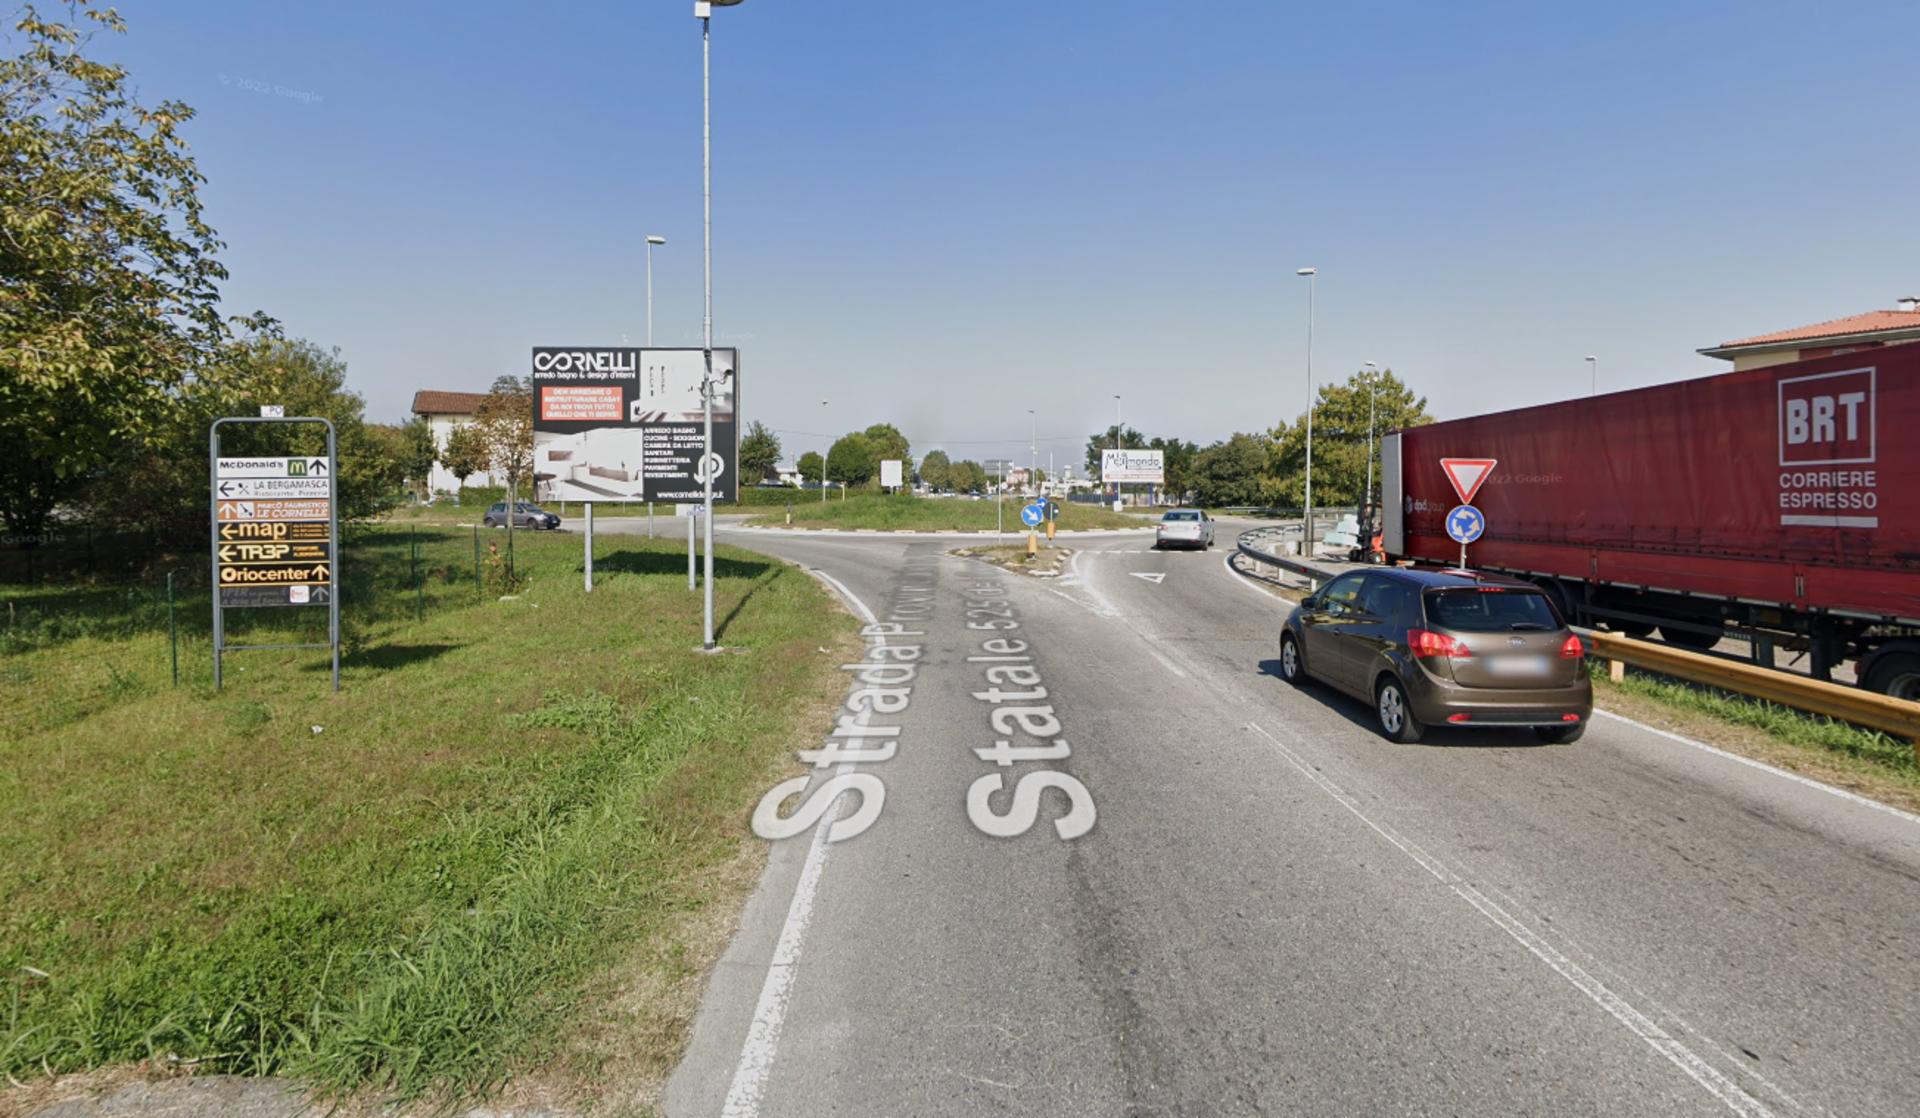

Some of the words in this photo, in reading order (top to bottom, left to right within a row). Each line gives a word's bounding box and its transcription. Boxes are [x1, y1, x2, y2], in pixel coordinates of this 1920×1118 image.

[534, 352, 636, 371] CORNELLI
[534, 371, 556, 379] arredo
[557, 371, 578, 380] bagno
[587, 371, 609, 380] design
[1786, 391, 1865, 445] BRT
[219, 461, 284, 469] McDonald's
[253, 481, 265, 490] LA
[267, 480, 328, 489] BERGAMASCA
[1779, 471, 1876, 489] CORRIERE
[1779, 492, 1877, 509] ESPRESSO
[256, 509, 270, 518] LE
[271, 508, 328, 518] CORNELLE
[239, 522, 287, 540] map
[221, 567, 311, 582] Oriocenter
